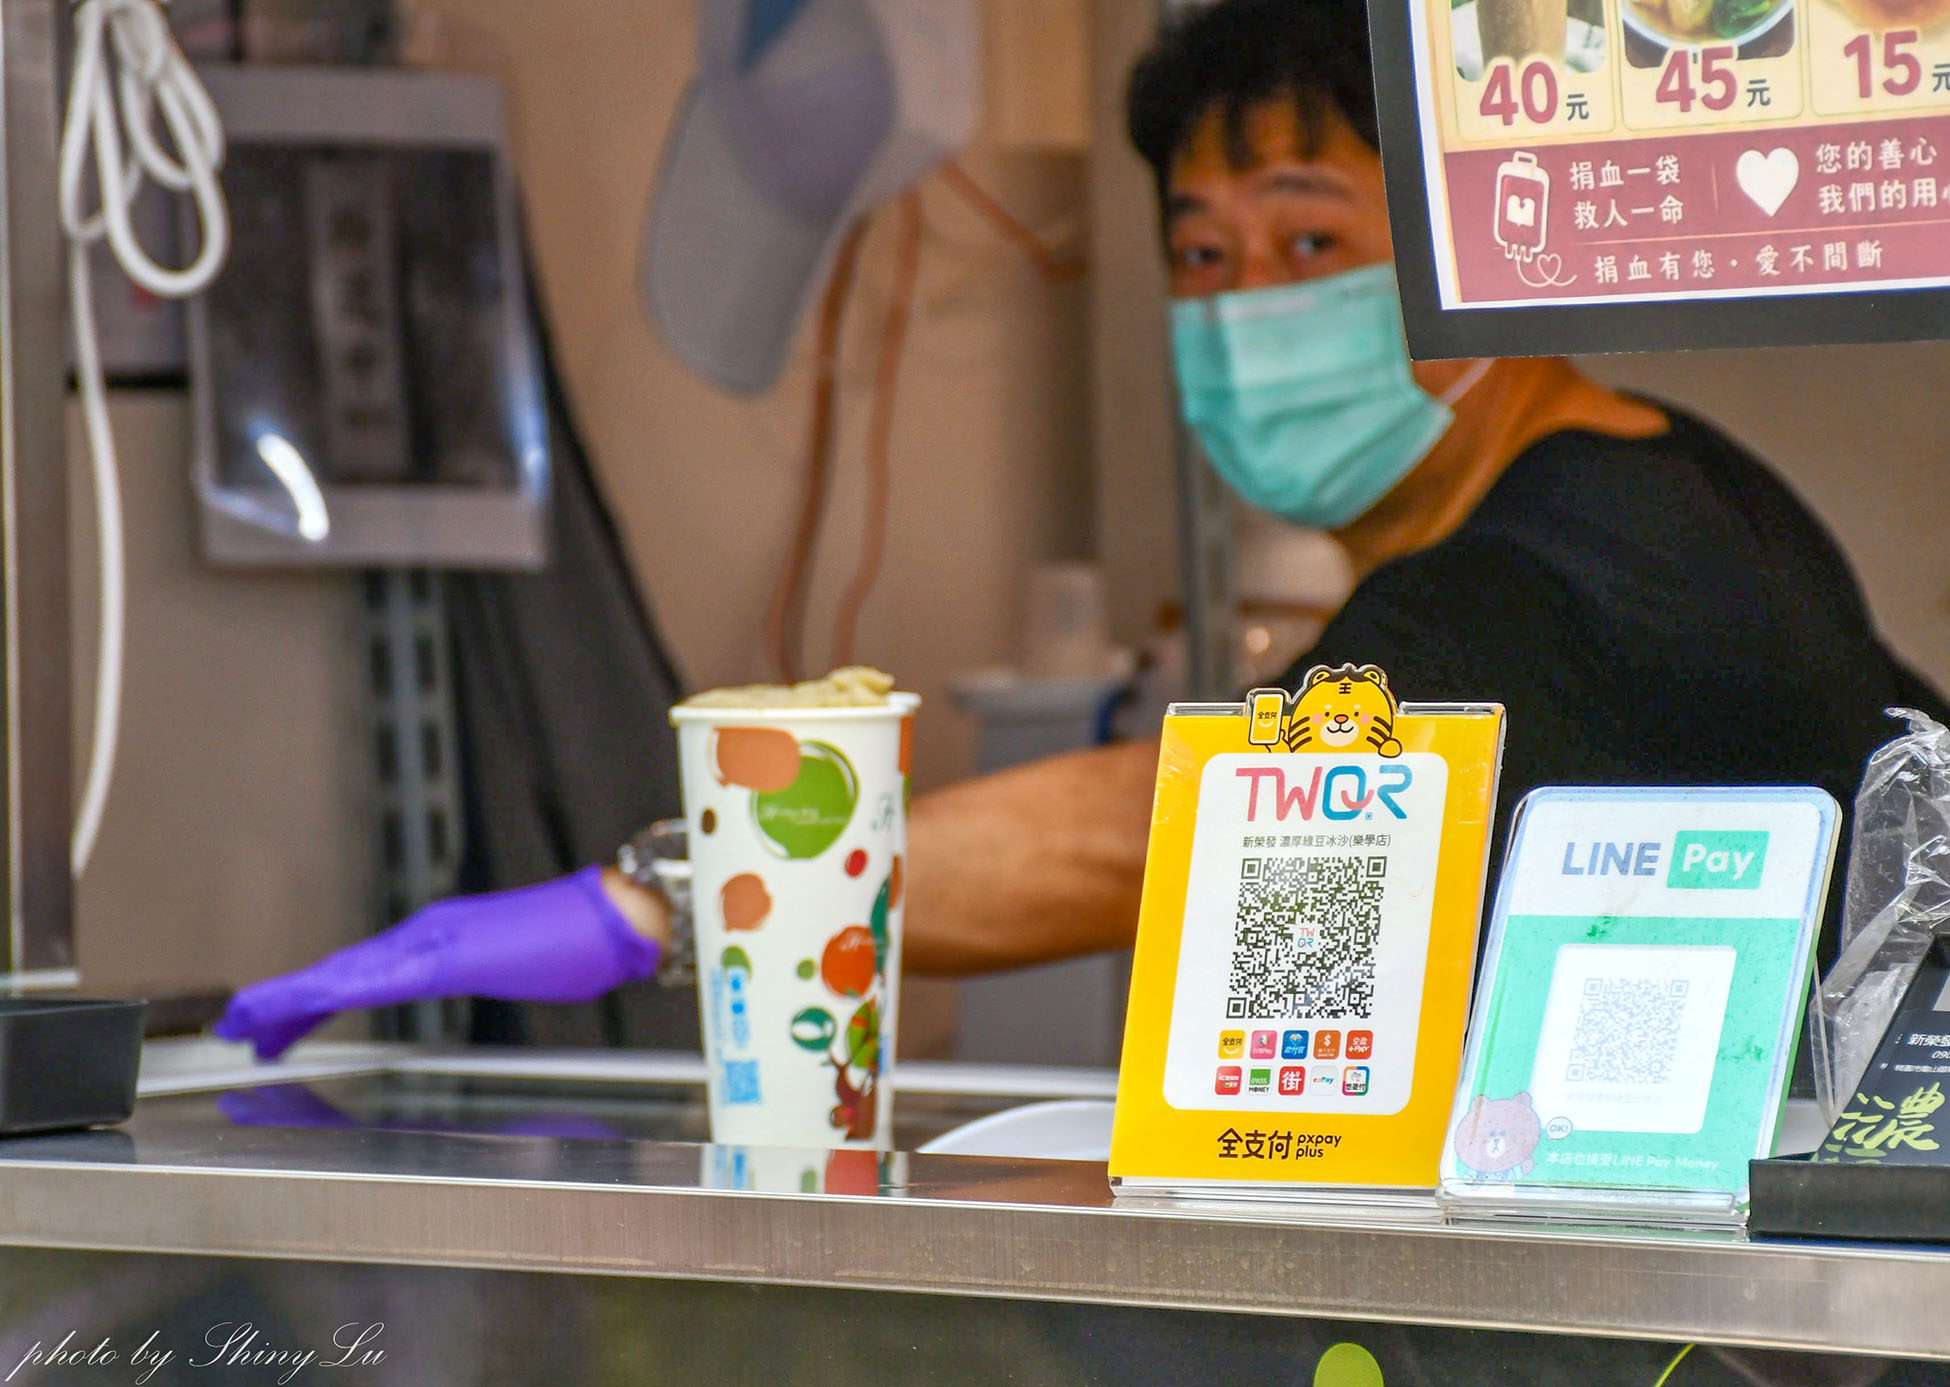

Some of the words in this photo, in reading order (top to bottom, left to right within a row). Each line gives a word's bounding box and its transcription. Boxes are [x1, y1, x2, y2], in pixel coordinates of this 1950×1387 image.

[1570, 155, 1681, 190] 捐血一袋
[1816, 137, 1938, 174] 您的善心
[1574, 194, 1684, 230] 救人一命
[1235, 764, 1413, 822] TWQR
[1561, 842, 1662, 876] LINE
[1682, 843, 1755, 880] Pay
[1217, 1128, 1293, 1160] 全支付
[1296, 1145, 1324, 1160] plus
[1297, 1134, 1342, 1148] pxpay
